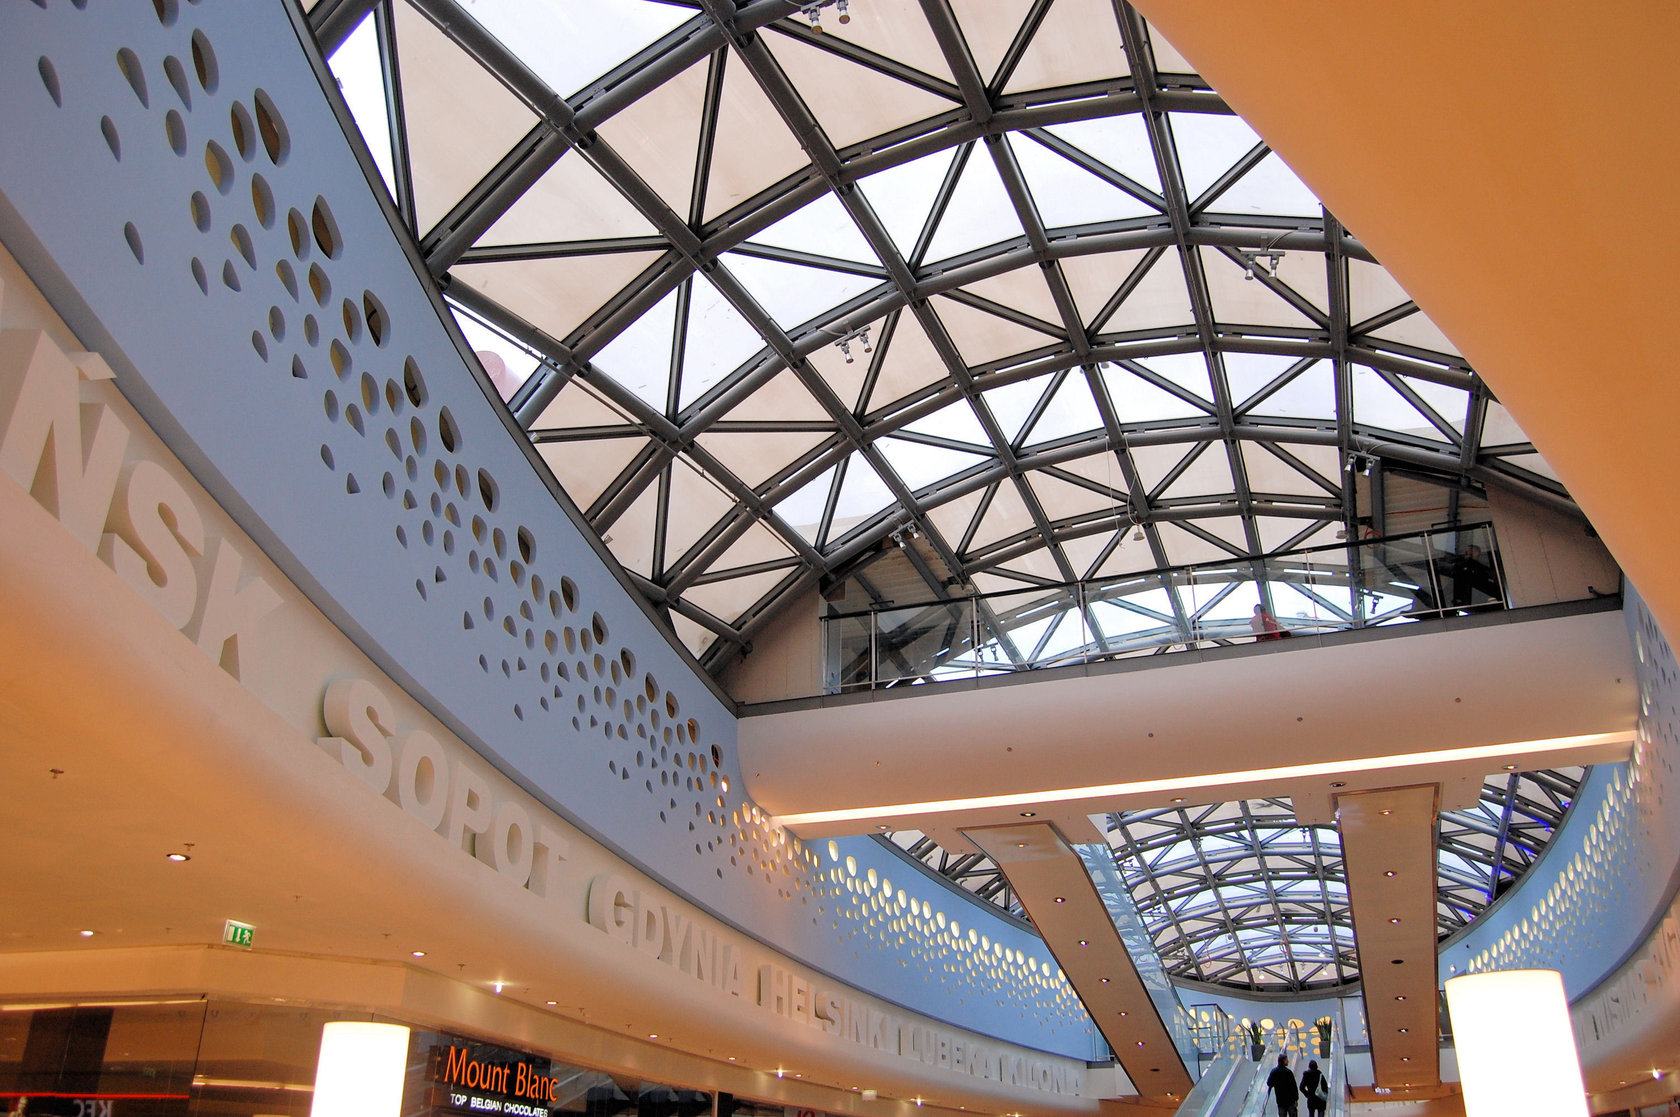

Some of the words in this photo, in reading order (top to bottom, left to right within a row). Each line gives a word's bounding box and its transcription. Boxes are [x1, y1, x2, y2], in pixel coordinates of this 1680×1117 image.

[0, 329, 284, 682] ŃSK
[317, 679, 569, 898] SOPOT
[588, 873, 744, 1000] GDYNIA
[759, 964, 894, 1053] HELSINKI
[444, 1045, 510, 1094] Mount
[515, 1062, 559, 1102] Blanc
[450, 1093, 468, 1105] TOP
[470, 1097, 502, 1111] BELGIAN
[504, 1102, 549, 1117] CHOCOLATES
